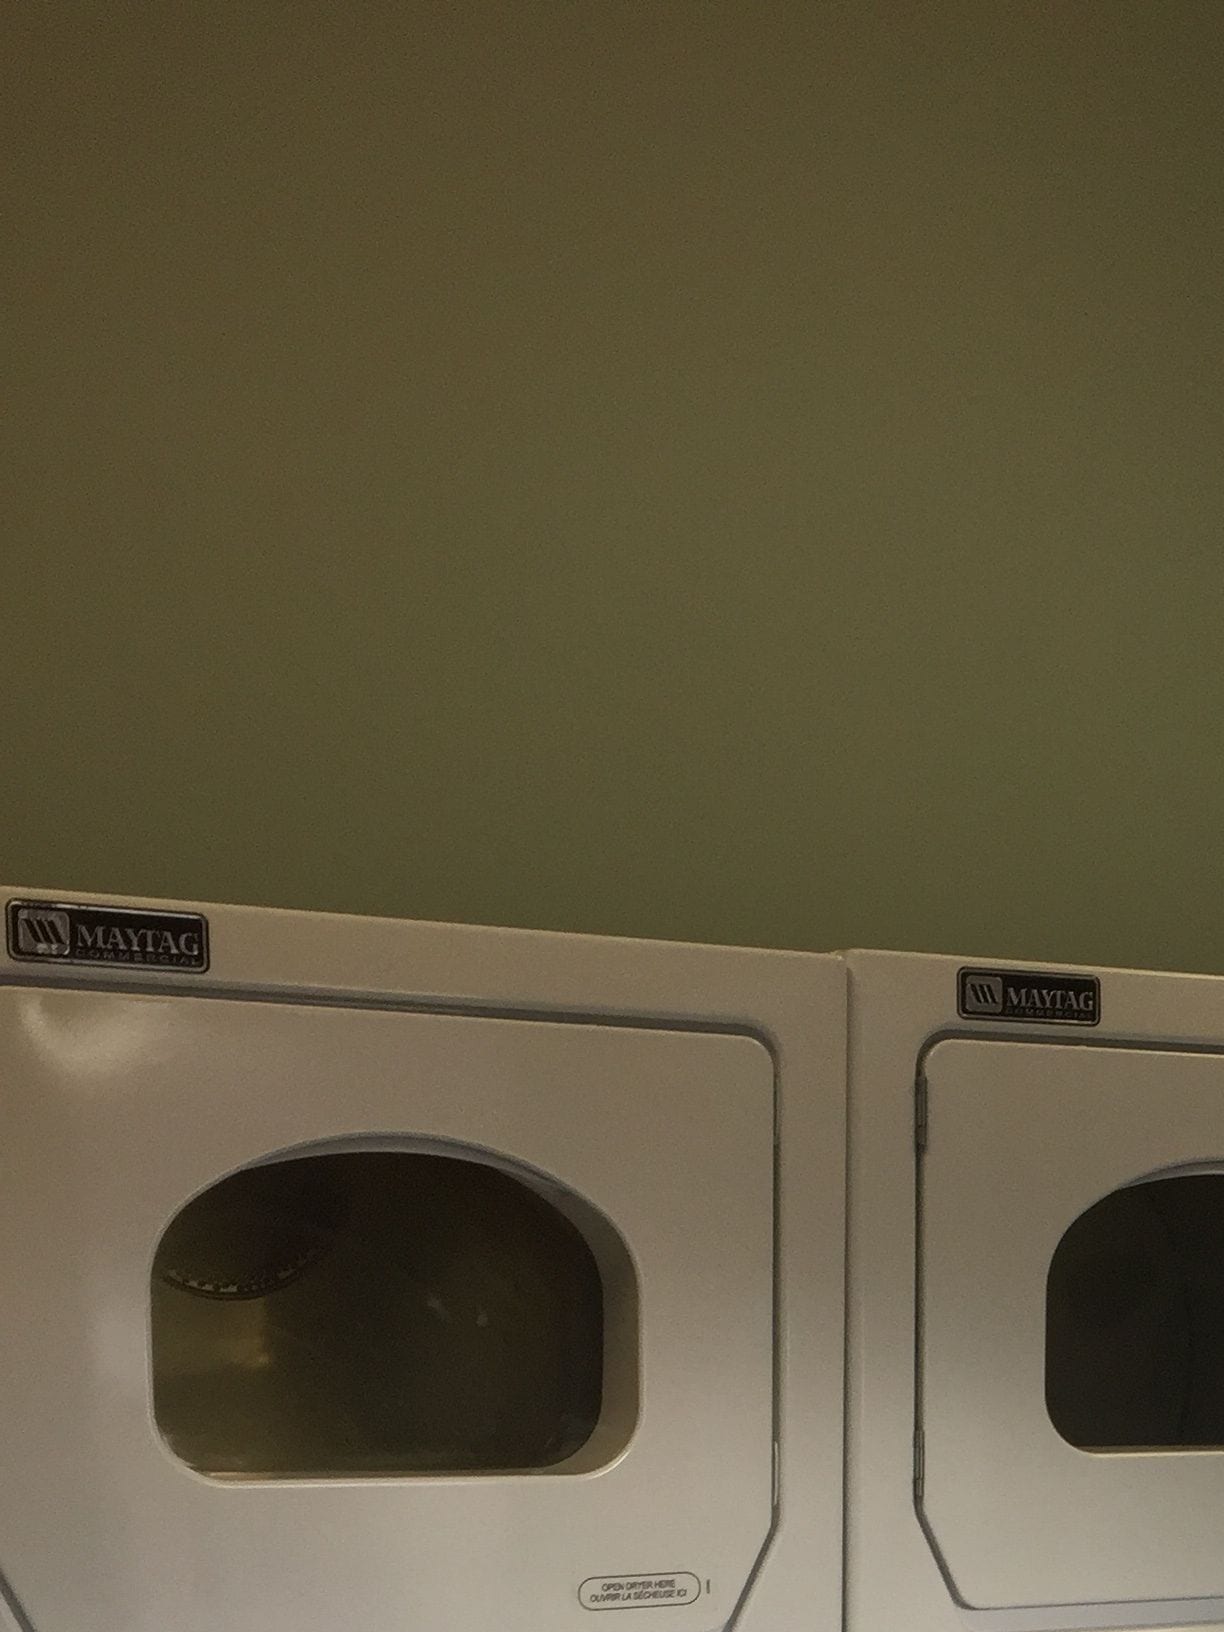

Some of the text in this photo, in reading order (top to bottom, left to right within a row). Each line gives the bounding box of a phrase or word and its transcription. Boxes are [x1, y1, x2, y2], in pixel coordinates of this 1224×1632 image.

[76, 924, 199, 955] MAYTAG
[76, 949, 199, 965] COMMERCIAL
[1006, 987, 1094, 1011] MAYTAG
[601, 1579, 675, 1592] OPEN DRYER HERE
[621, 1592, 631, 1601] LA
